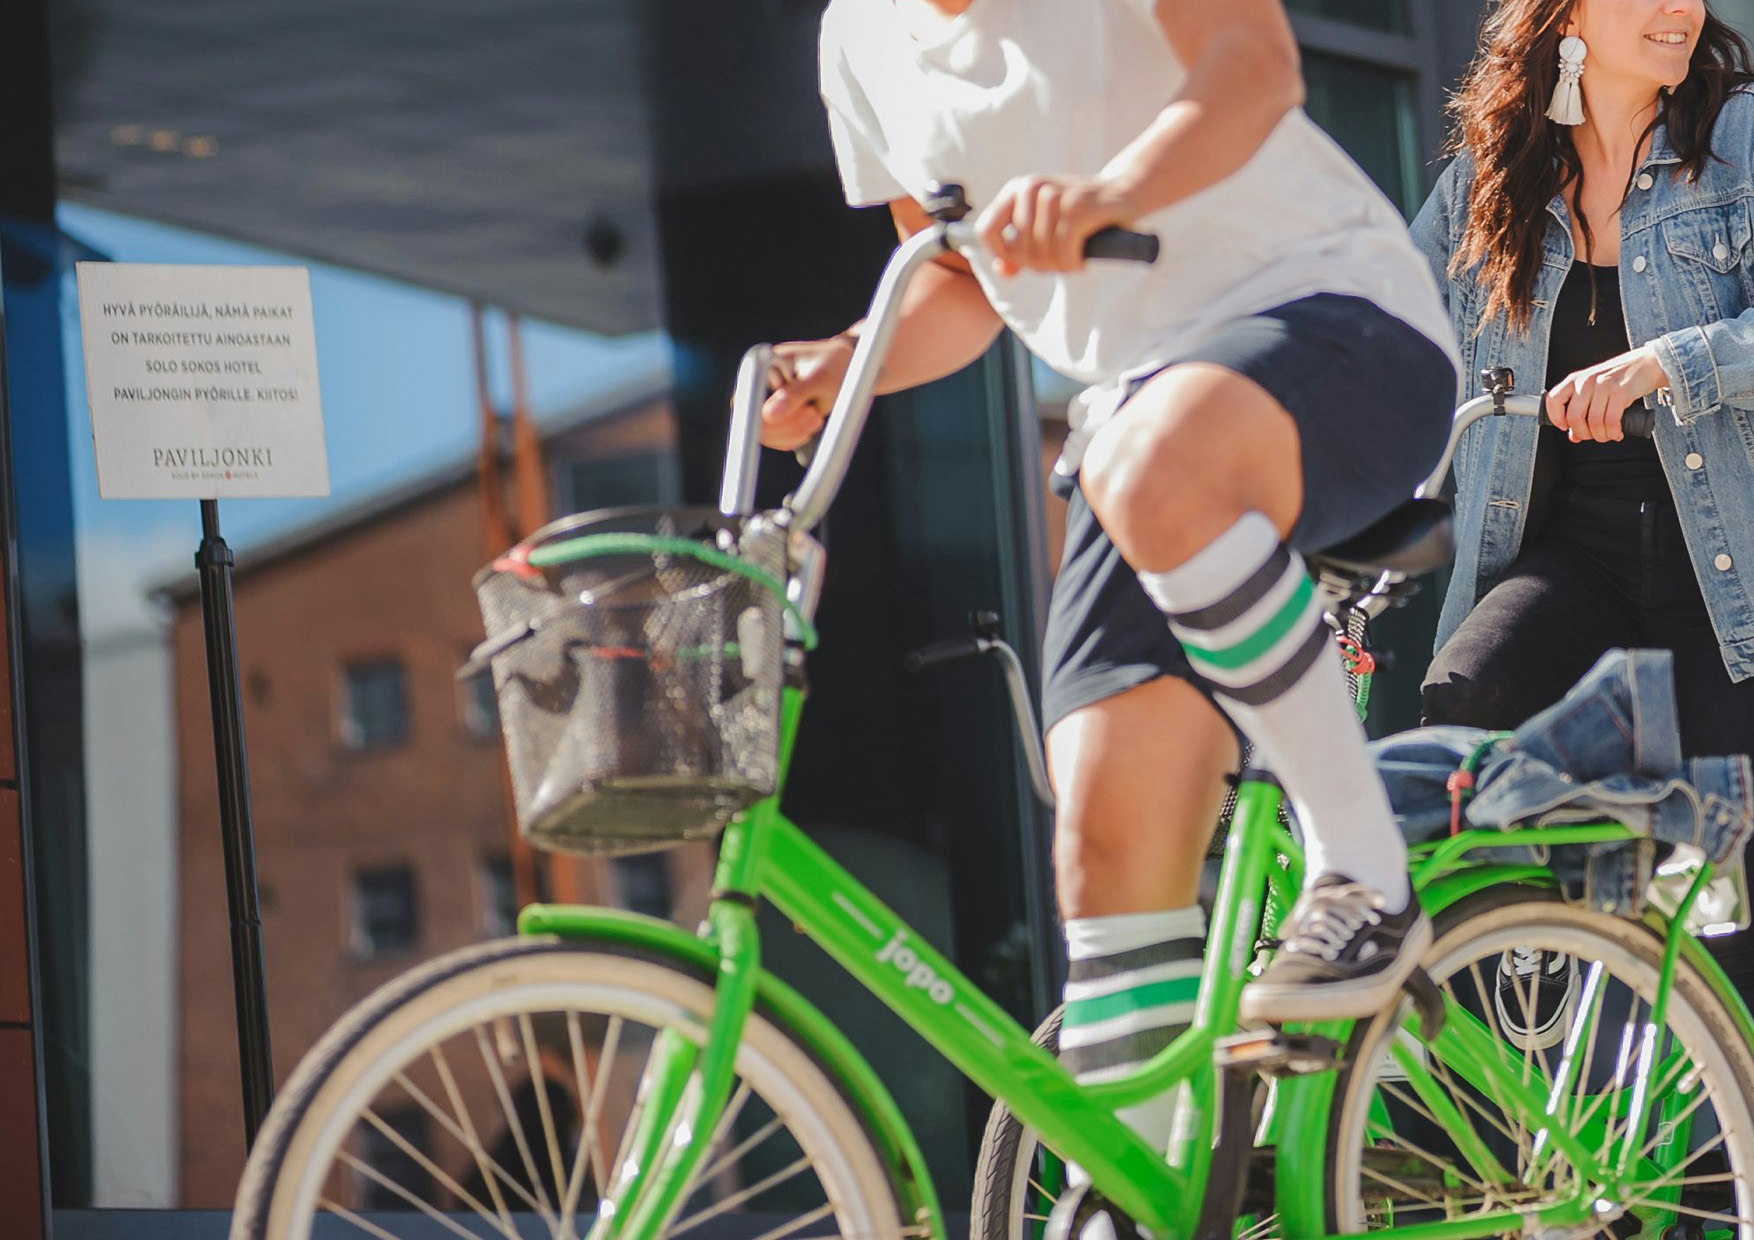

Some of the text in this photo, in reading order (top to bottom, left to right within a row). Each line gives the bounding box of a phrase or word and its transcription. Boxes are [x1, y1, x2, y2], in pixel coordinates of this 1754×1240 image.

[103, 301, 136, 317] HYVÄ
[215, 302, 250, 319] NÄMÄ
[253, 305, 293, 320] PAIKAT
[111, 331, 291, 347] ON TARKOITETTU AINOASTAAN
[145, 360, 262, 375] SOLO SOKOS HOTEL
[114, 387, 191, 401] PAVILJONGIN
[152, 447, 273, 468] PAVILJONKI
[875, 928, 953, 1005] jopo
